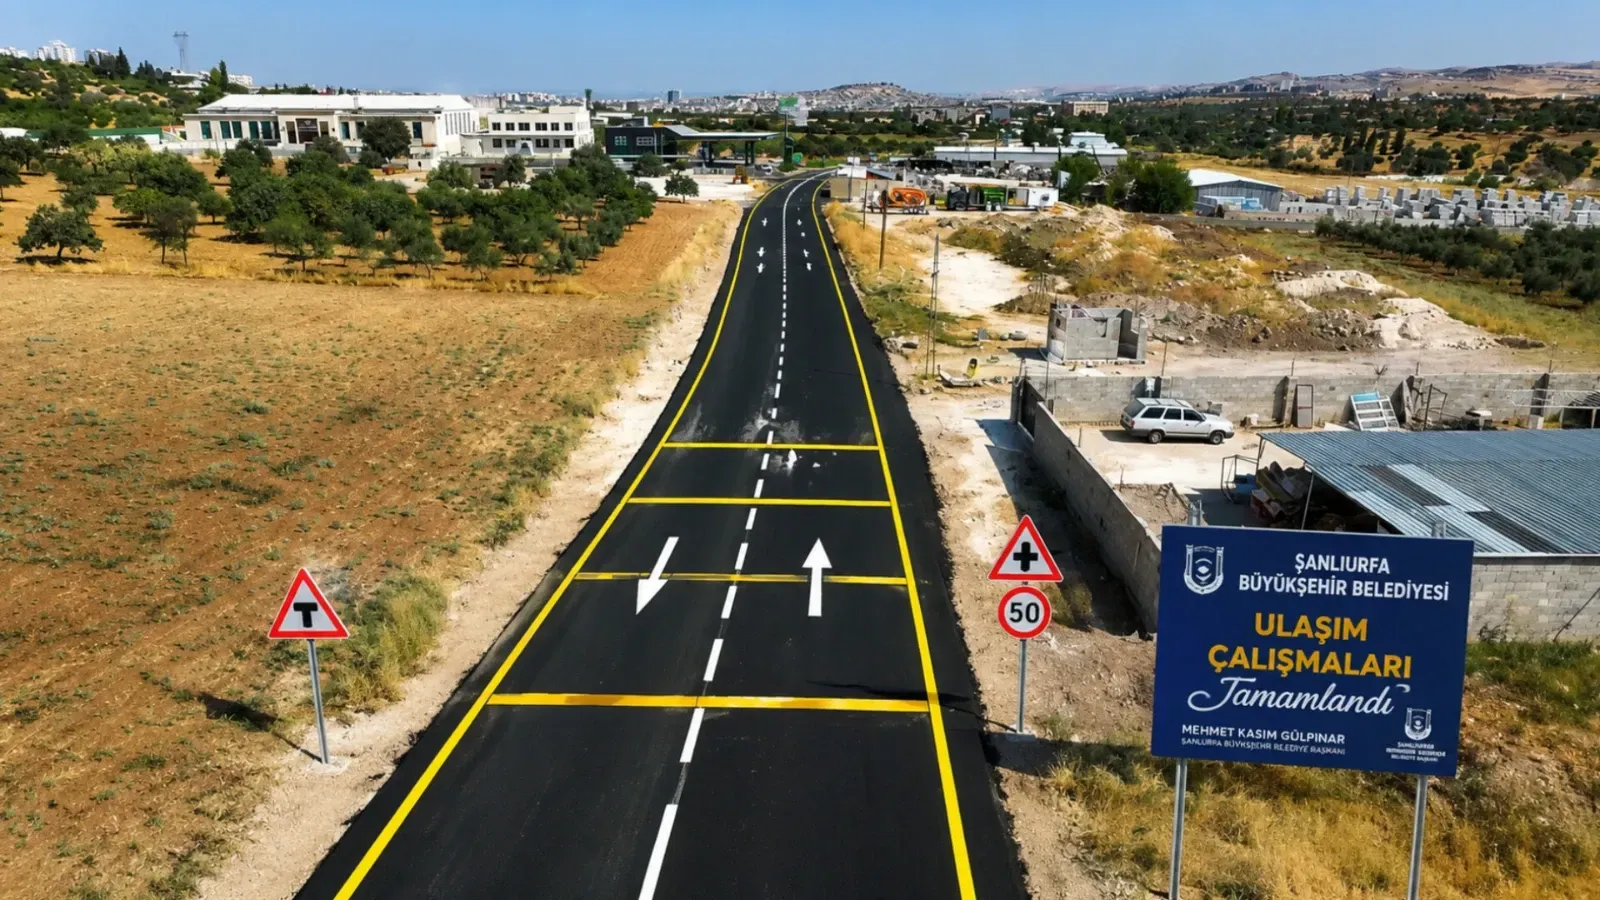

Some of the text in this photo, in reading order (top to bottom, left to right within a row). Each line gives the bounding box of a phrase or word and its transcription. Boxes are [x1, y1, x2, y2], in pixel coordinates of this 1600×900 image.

[1294, 553, 1390, 575] ŞANLIURFA
[1352, 578, 1449, 601] BELEDİYESİ
[1009, 602, 1040, 624] 50
[1255, 612, 1368, 645] ULAŞIM
[1208, 644, 1412, 678] ÇALIŞMALARI
[1187, 676, 1411, 715] Tamamlandı
[1181, 724, 1235, 737] MEHMET
[1238, 727, 1277, 740] KASIM
